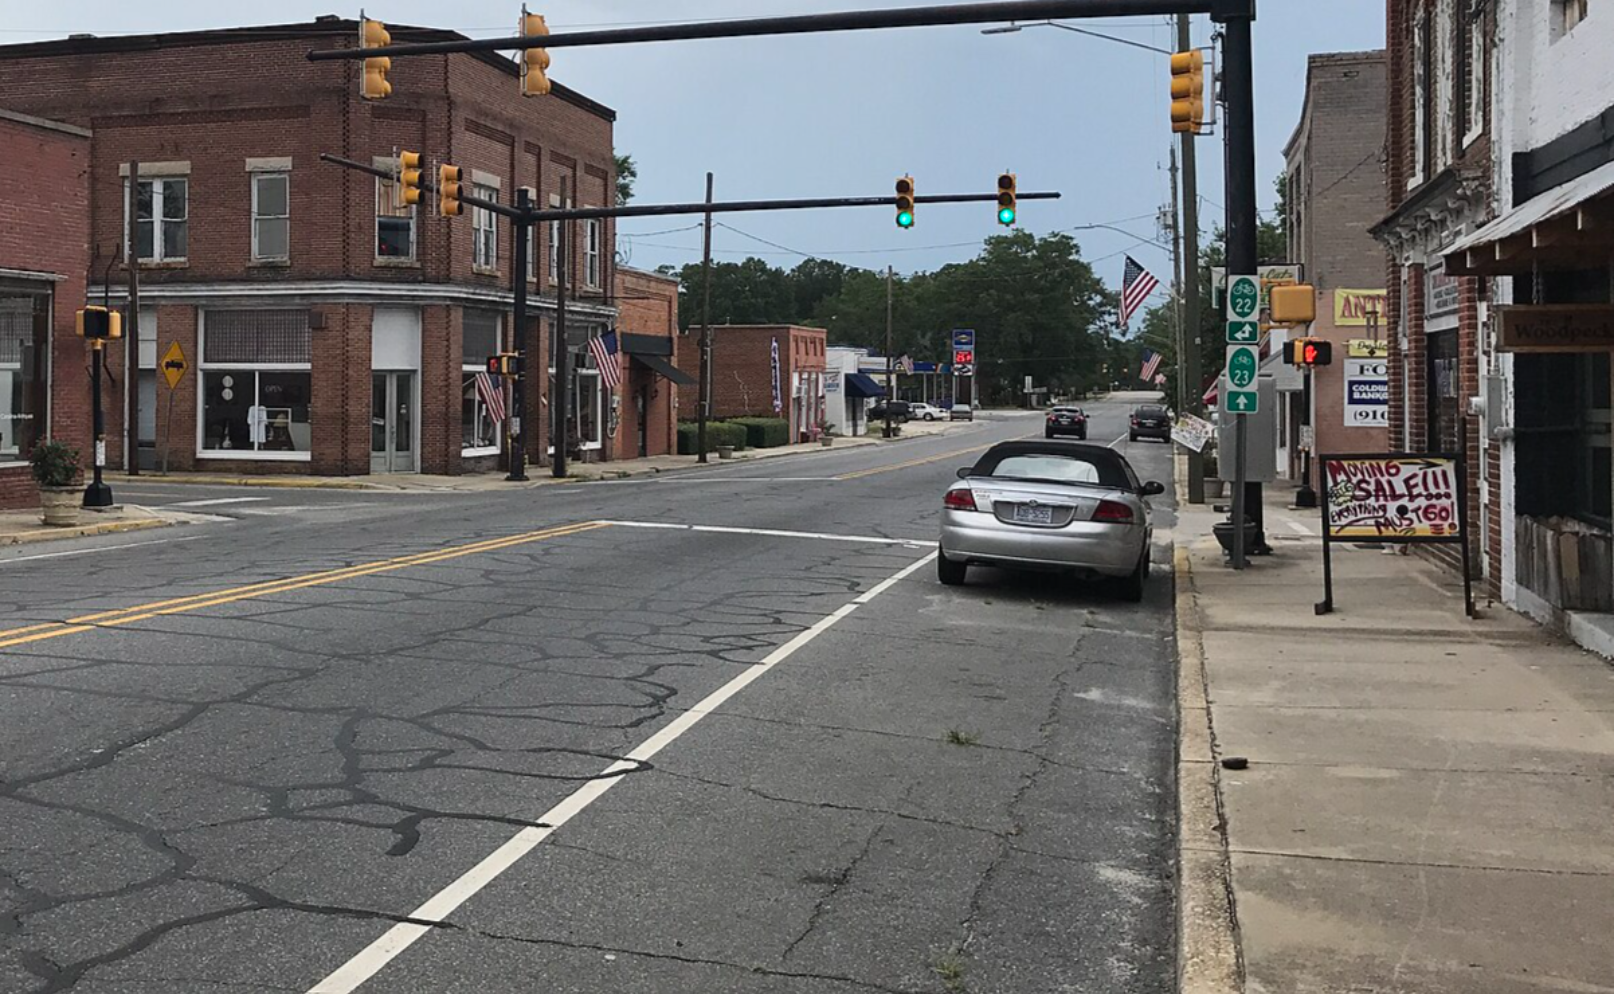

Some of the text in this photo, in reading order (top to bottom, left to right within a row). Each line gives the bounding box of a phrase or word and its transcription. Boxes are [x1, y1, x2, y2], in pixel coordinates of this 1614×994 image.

[1235, 298, 1251, 312] 22
[1233, 370, 1249, 385] 23
[1354, 470, 1452, 502] SALE!!!
[1374, 501, 1458, 534] MUST GO!
